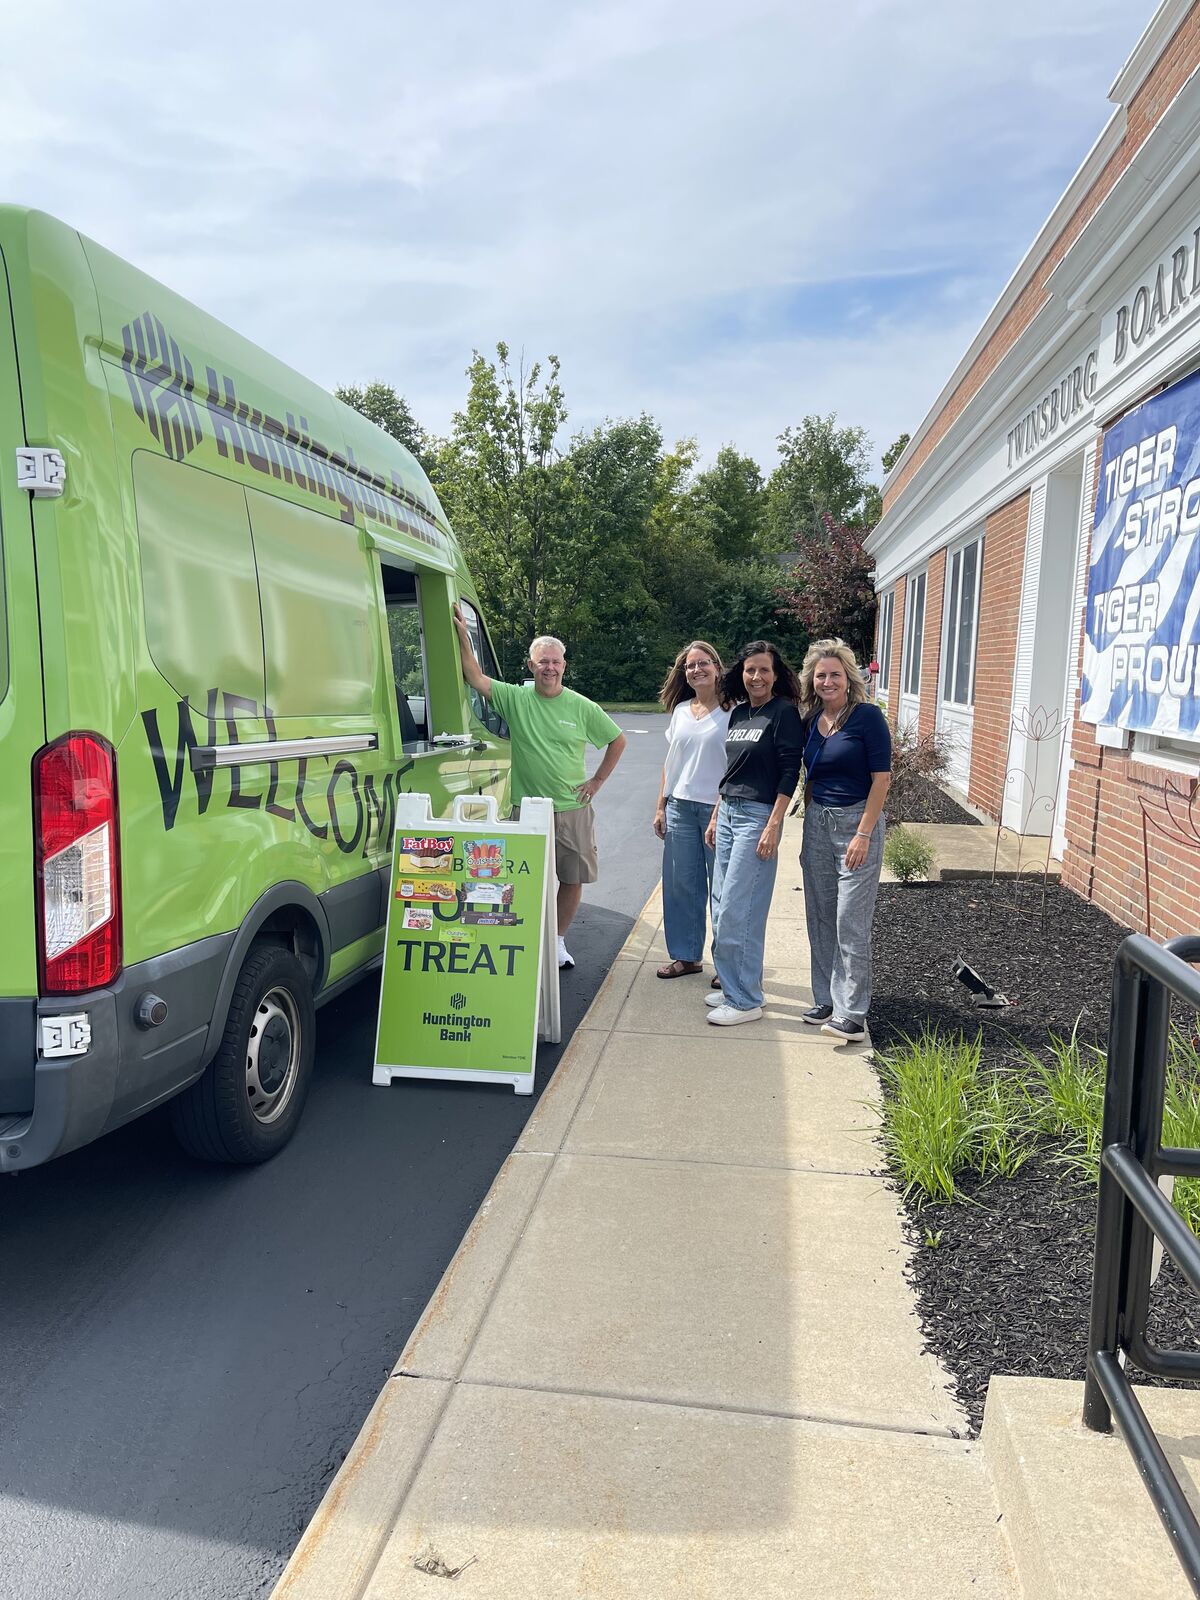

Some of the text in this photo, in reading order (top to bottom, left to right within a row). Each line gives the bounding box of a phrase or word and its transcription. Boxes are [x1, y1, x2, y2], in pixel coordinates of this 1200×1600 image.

[1006, 351, 1098, 468] TWINSBURG
[206, 365, 391, 525] Huntington
[1105, 424, 1177, 504] TIGER
[1094, 581, 1160, 636] TIGER
[1110, 643, 1200, 698] PROU
[725, 728, 764, 743] LEVELAND
[403, 837, 455, 852] FatBoy
[397, 939, 525, 976] TREAT
[422, 1012, 491, 1030] Huntington
[439, 1028, 472, 1043] Bank
